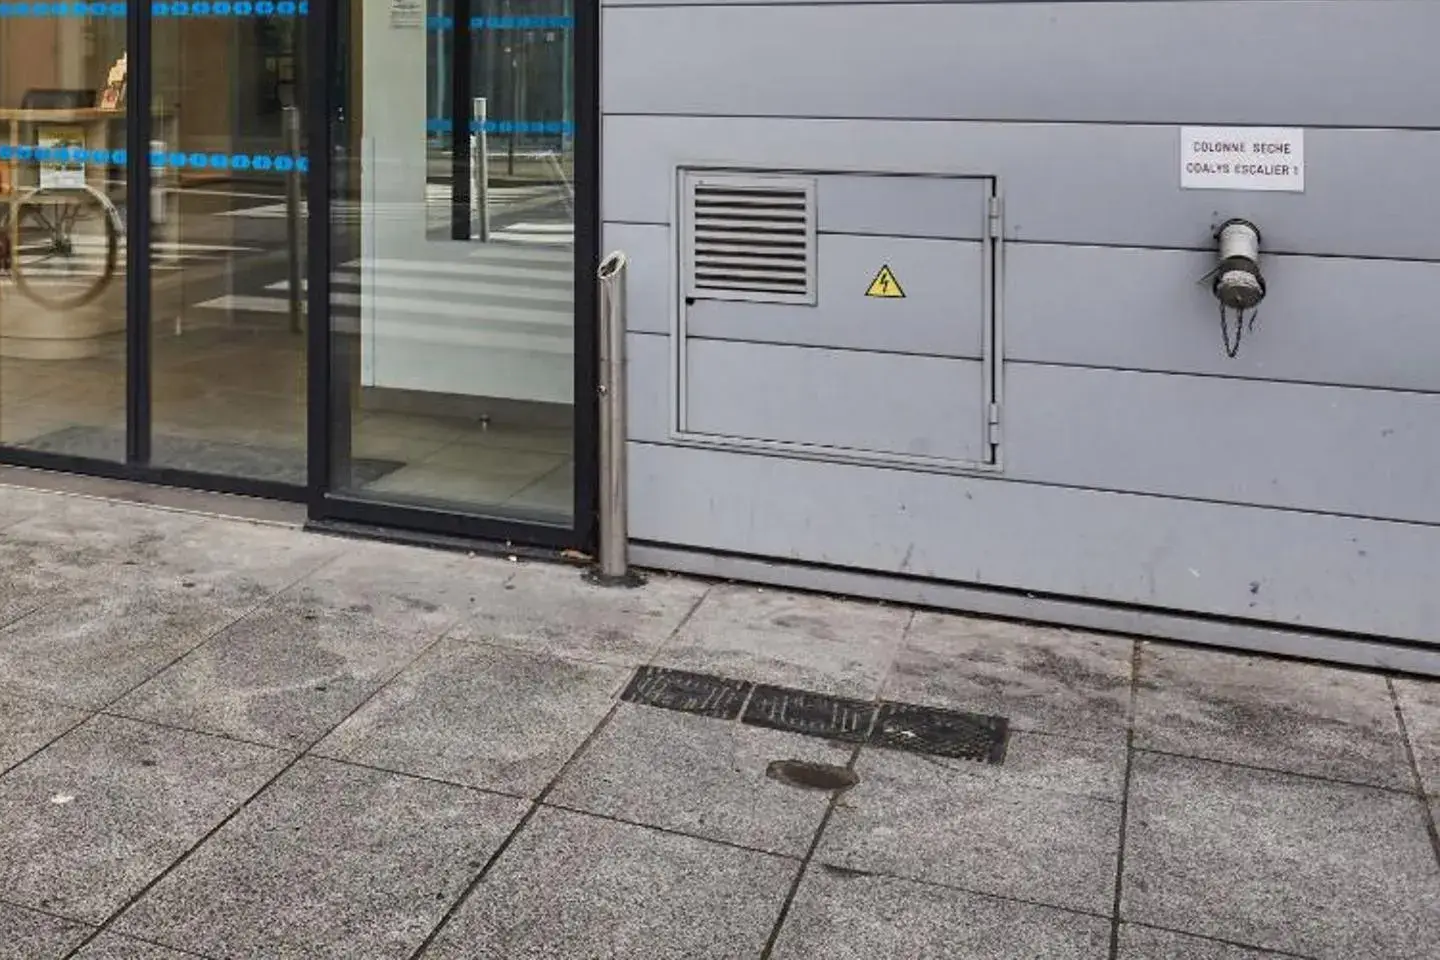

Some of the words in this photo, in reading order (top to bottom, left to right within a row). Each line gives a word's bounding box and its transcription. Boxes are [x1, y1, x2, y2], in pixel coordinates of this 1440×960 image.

[1193, 141, 1246, 153] COLONNE
[1253, 143, 1291, 154] SECHE
[1234, 165, 1289, 176] ESCALIER
